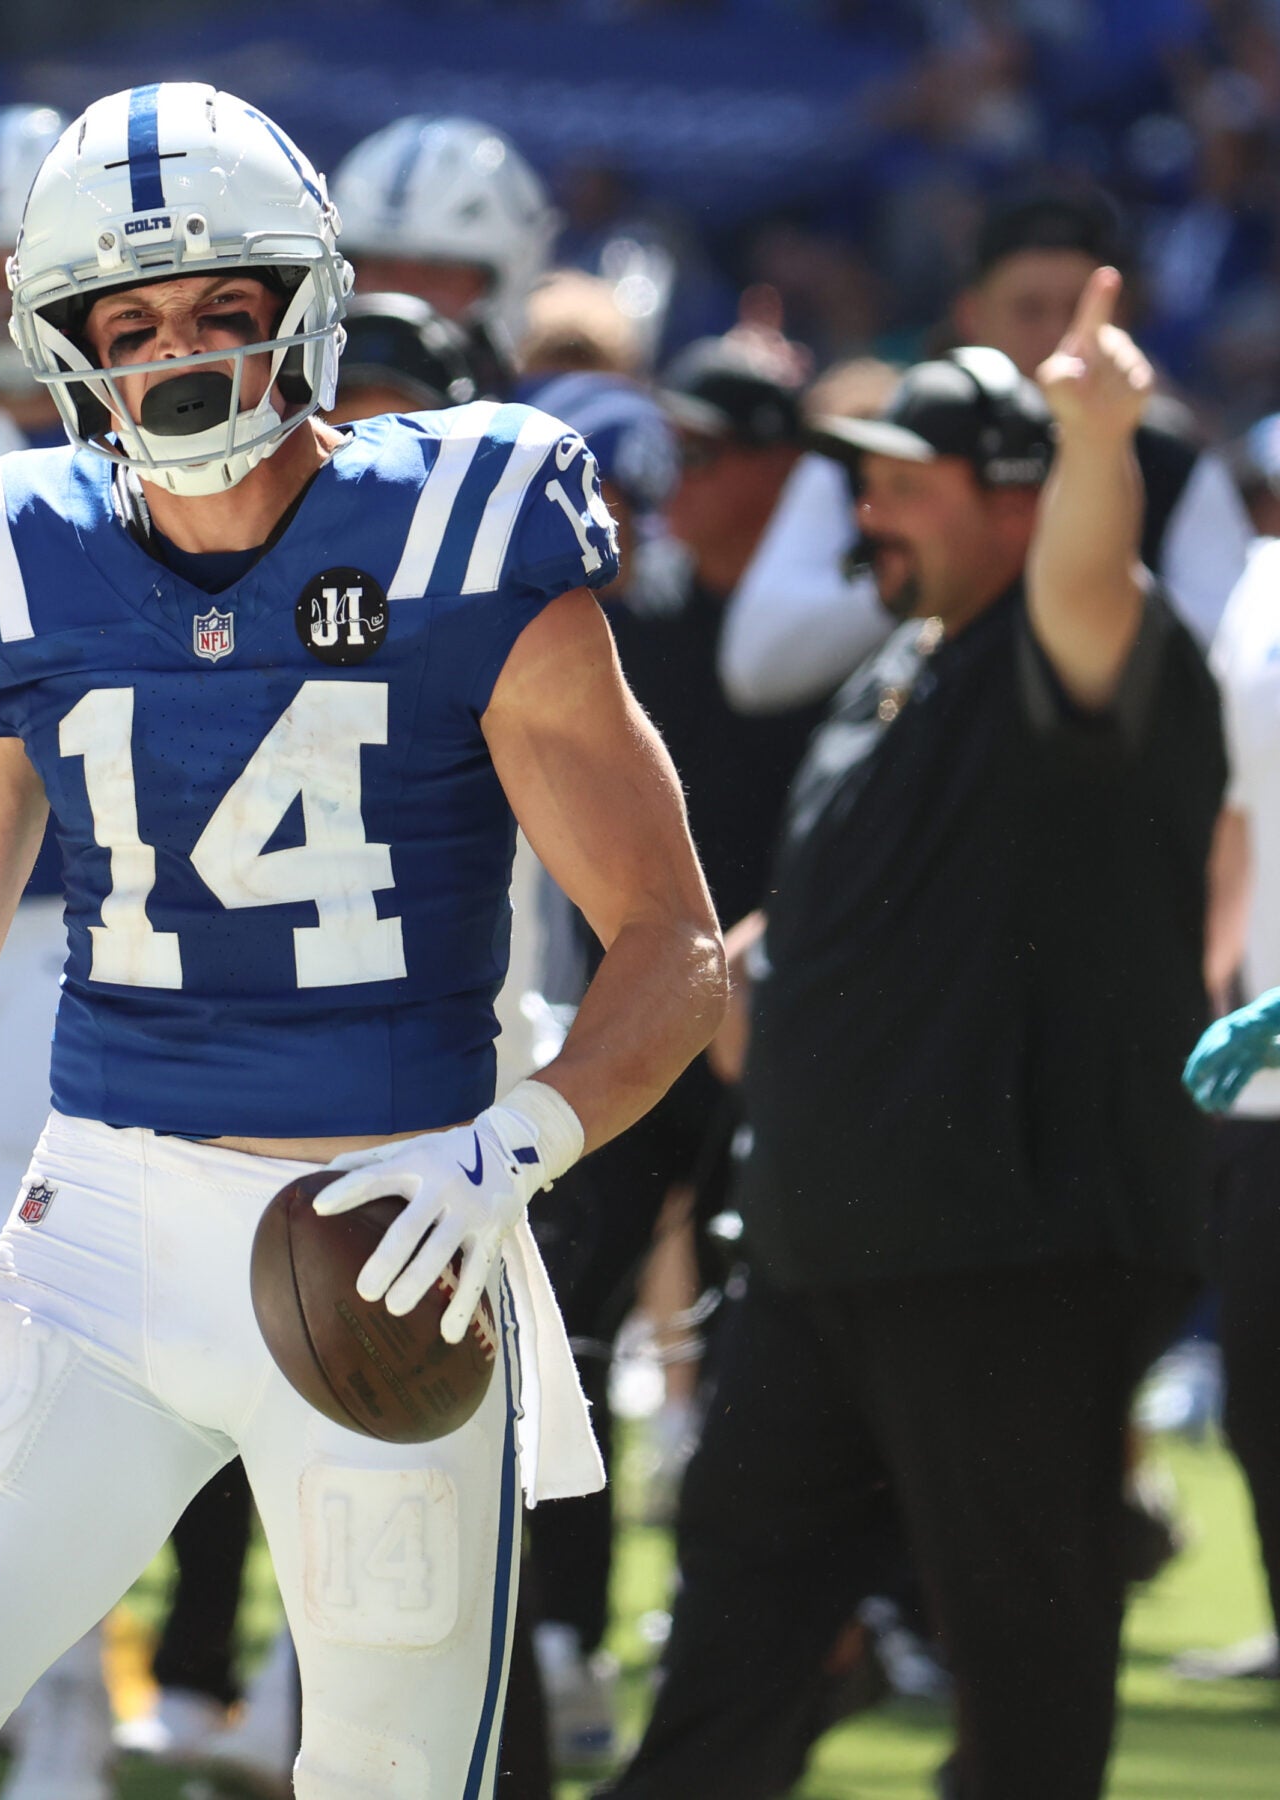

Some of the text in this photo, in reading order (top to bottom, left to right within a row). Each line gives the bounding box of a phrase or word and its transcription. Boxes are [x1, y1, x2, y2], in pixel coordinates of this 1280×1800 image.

[125, 216, 171, 235] COLTS
[200, 631, 228, 652] NFL
[58, 680, 407, 989] 14
[22, 1200, 43, 1220] NFL
[334, 1300, 380, 1361] NATIONAL
[323, 1490, 435, 1611] 14
